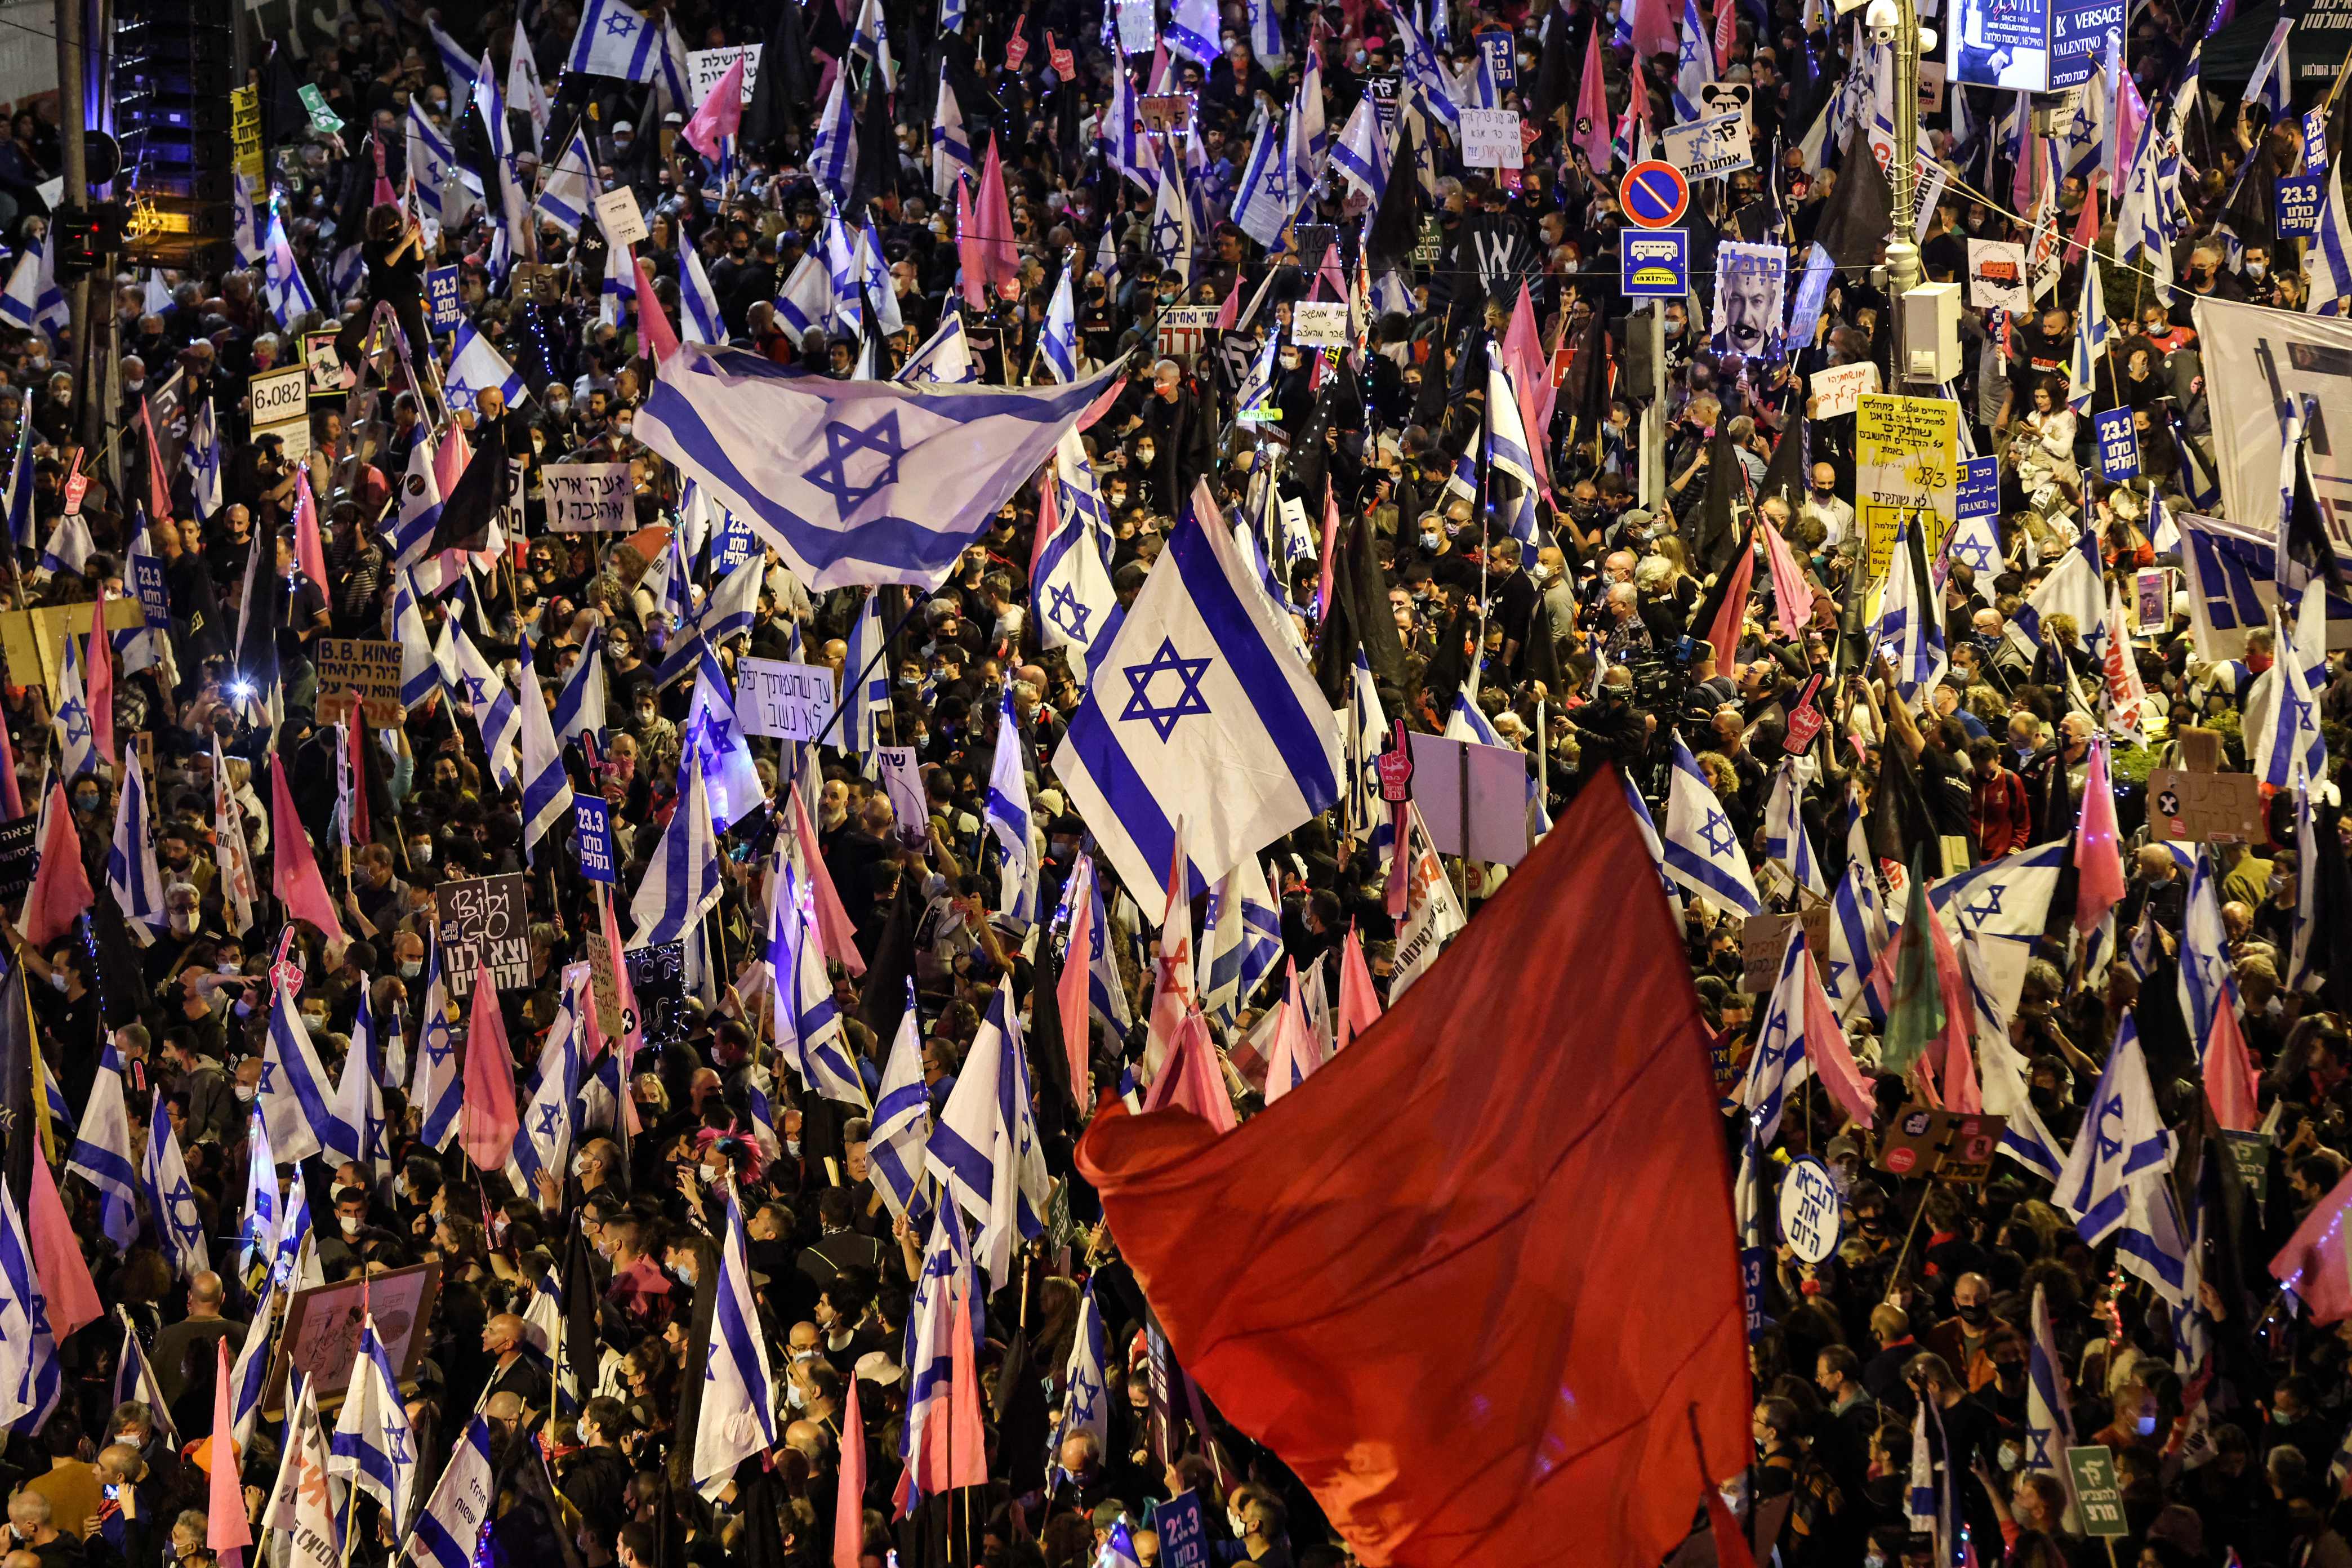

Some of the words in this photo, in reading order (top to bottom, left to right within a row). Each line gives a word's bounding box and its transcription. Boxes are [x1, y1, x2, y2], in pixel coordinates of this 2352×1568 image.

[2074, 5, 2122, 30] VERSACE
[1999, 23, 2029, 32] COLLECTION
[2030, 25, 2041, 34] 2020
[1984, 32, 2001, 42] מלחה
[2001, 34, 2019, 44] שכונת
[2028, 37, 2043, 47] האייל
[2053, 35, 2100, 57] VALENTINO
[2302, 63, 2329, 77] השלטון
[2053, 72, 2072, 85] מלחה
[2306, 116, 2323, 140] 23.3
[2310, 137, 2323, 154] כולנו
[1709, 153, 1741, 170] אנחנו
[2282, 185, 2318, 204] 23.3
[2287, 204, 2314, 217] כולנו
[433, 277, 456, 297] 23.3
[437, 297, 456, 311] כולנו
[435, 309, 460, 324] בקלפי!
[1828, 369, 1866, 384] מושחתיהו
[255, 381, 301, 410] 6,082
[1863, 399, 1895, 412] מתחילים
[1901, 402, 1919, 415] שלנו
[1922, 407, 1948, 416] החיים
[1869, 412, 1882, 422] אנו
[1885, 413, 1894, 422] בו
[1896, 415, 1913, 424] ביום
[1859, 430, 1891, 442] החשובים
[2101, 417, 2132, 442] 23.3
[1894, 436, 1928, 448] הדברים
[1933, 439, 1944, 448] על
[2107, 440, 2132, 458] כולנו
[1881, 445, 1905, 457] באמת
[2105, 453, 2137, 474] בקלפי!
[1914, 460, 1948, 488] 23/3
[1973, 467, 1992, 477] כיכר
[548, 476, 582, 499] ארץ
[1872, 491, 1910, 506] שותקים
[1915, 493, 1927, 507] לא
[570, 501, 624, 520] אהובה
[1958, 500, 1989, 515] (FRANCE)
[729, 536, 747, 551] כולנו
[138, 565, 162, 587] 23.3
[143, 589, 161, 603] כולנו
[362, 644, 402, 663] KING
[318, 663, 350, 676] אחד
[350, 664, 372, 680] רק
[377, 665, 400, 681] היה
[319, 678, 341, 694] על
[371, 685, 400, 699] והוא
[813, 678, 830, 703] עד
[801, 703, 822, 736] לא
[577, 807, 604, 833] 23.3
[582, 834, 603, 853] כולנו
[581, 848, 610, 870] בקלפי!
[450, 880, 510, 919] Bibi
[461, 910, 509, 953] GO
[447, 942, 479, 972] לנו
[489, 937, 529, 966] וצא
[1797, 1197, 1821, 1230] את
[2079, 1460, 2104, 1487] לך
[2086, 1504, 2119, 1521] מרצ
